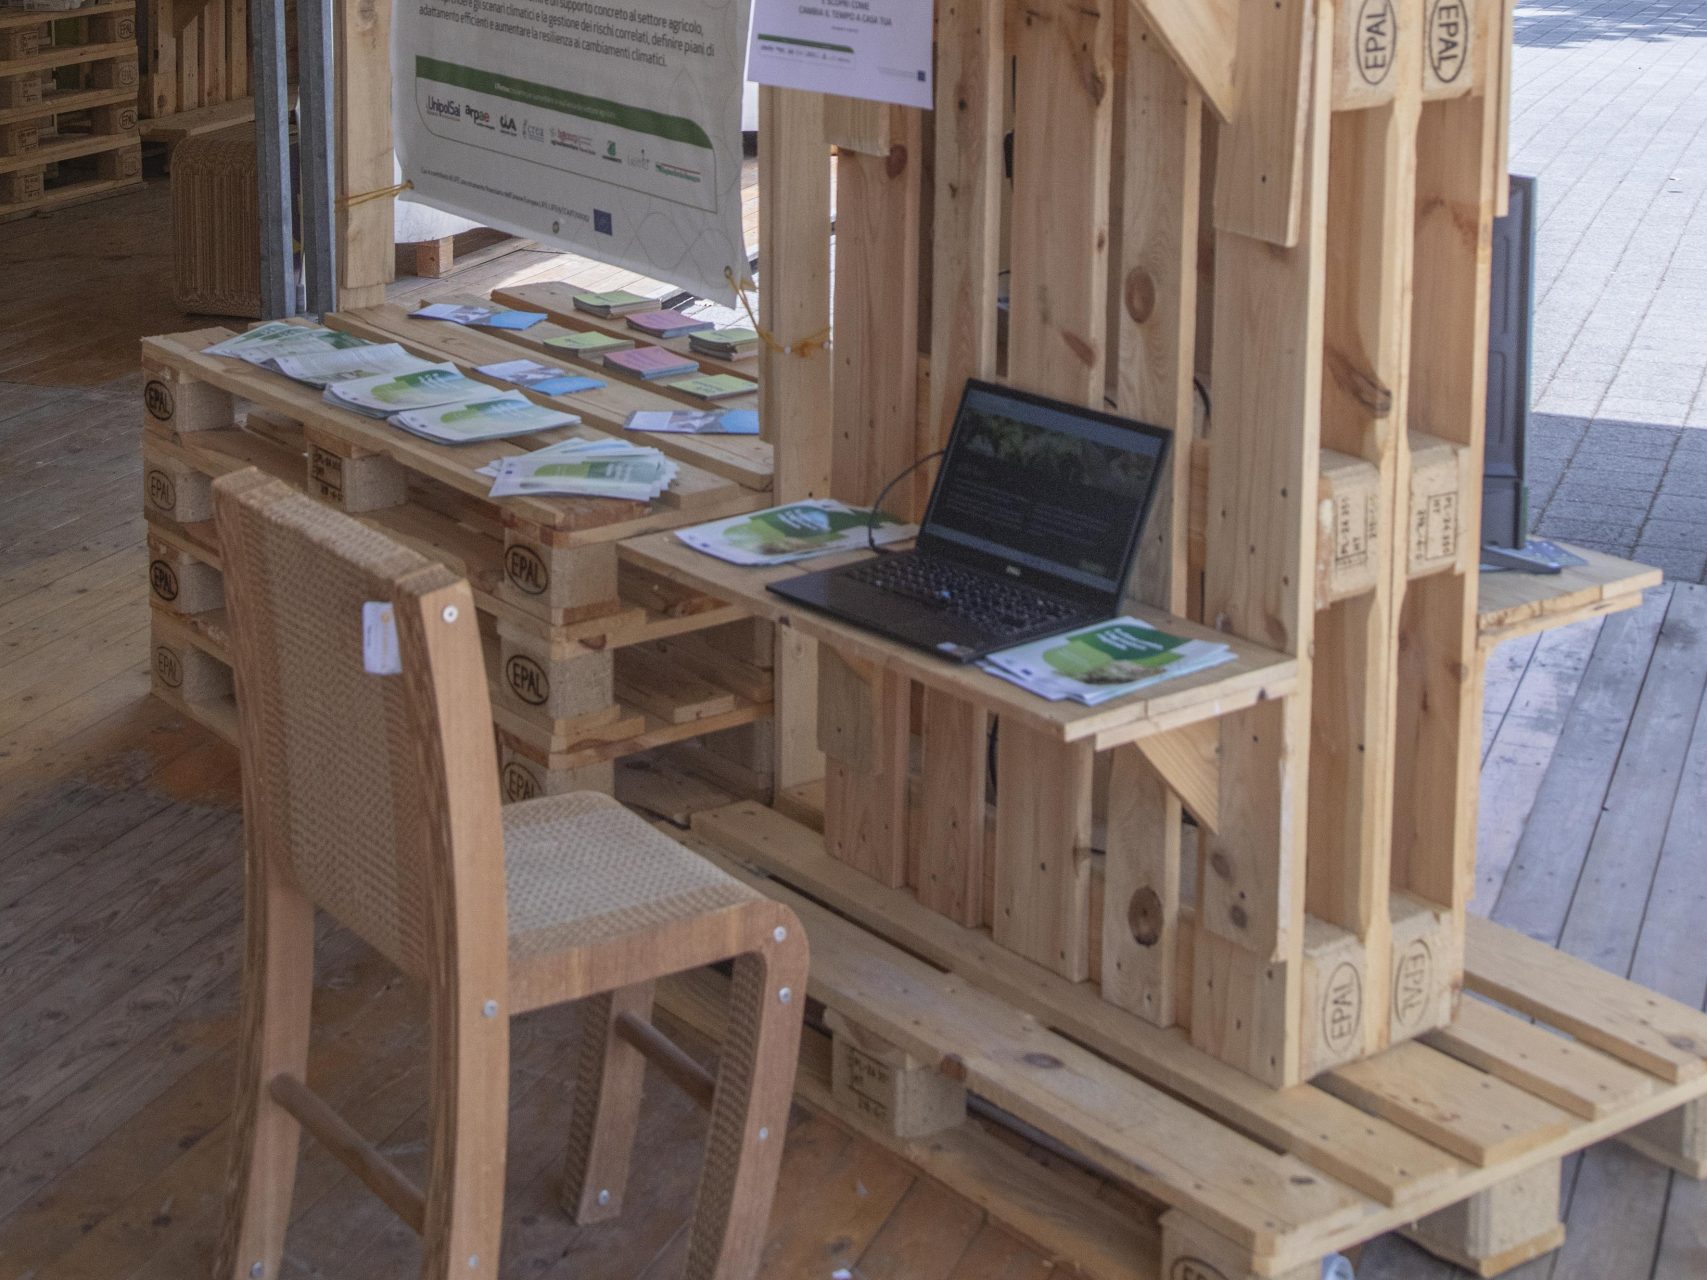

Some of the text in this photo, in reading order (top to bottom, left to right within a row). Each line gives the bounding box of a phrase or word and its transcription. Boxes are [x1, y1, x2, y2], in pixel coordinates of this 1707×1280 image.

[548, 14, 579, 30] gestione
[593, 21, 614, 37] rischi
[651, 32, 683, 50] definire
[594, 4, 628, 21] concreto
[637, 11, 667, 28] settore
[582, 39, 631, 60] cambiamenti
[1365, 1, 1388, 70] EPAL
[1436, 4, 1460, 70] EPAL
[151, 476, 172, 506] EPAL
[511, 552, 542, 589] EPAL
[513, 662, 544, 699] EPAL
[1330, 976, 1353, 1040] EPAL
